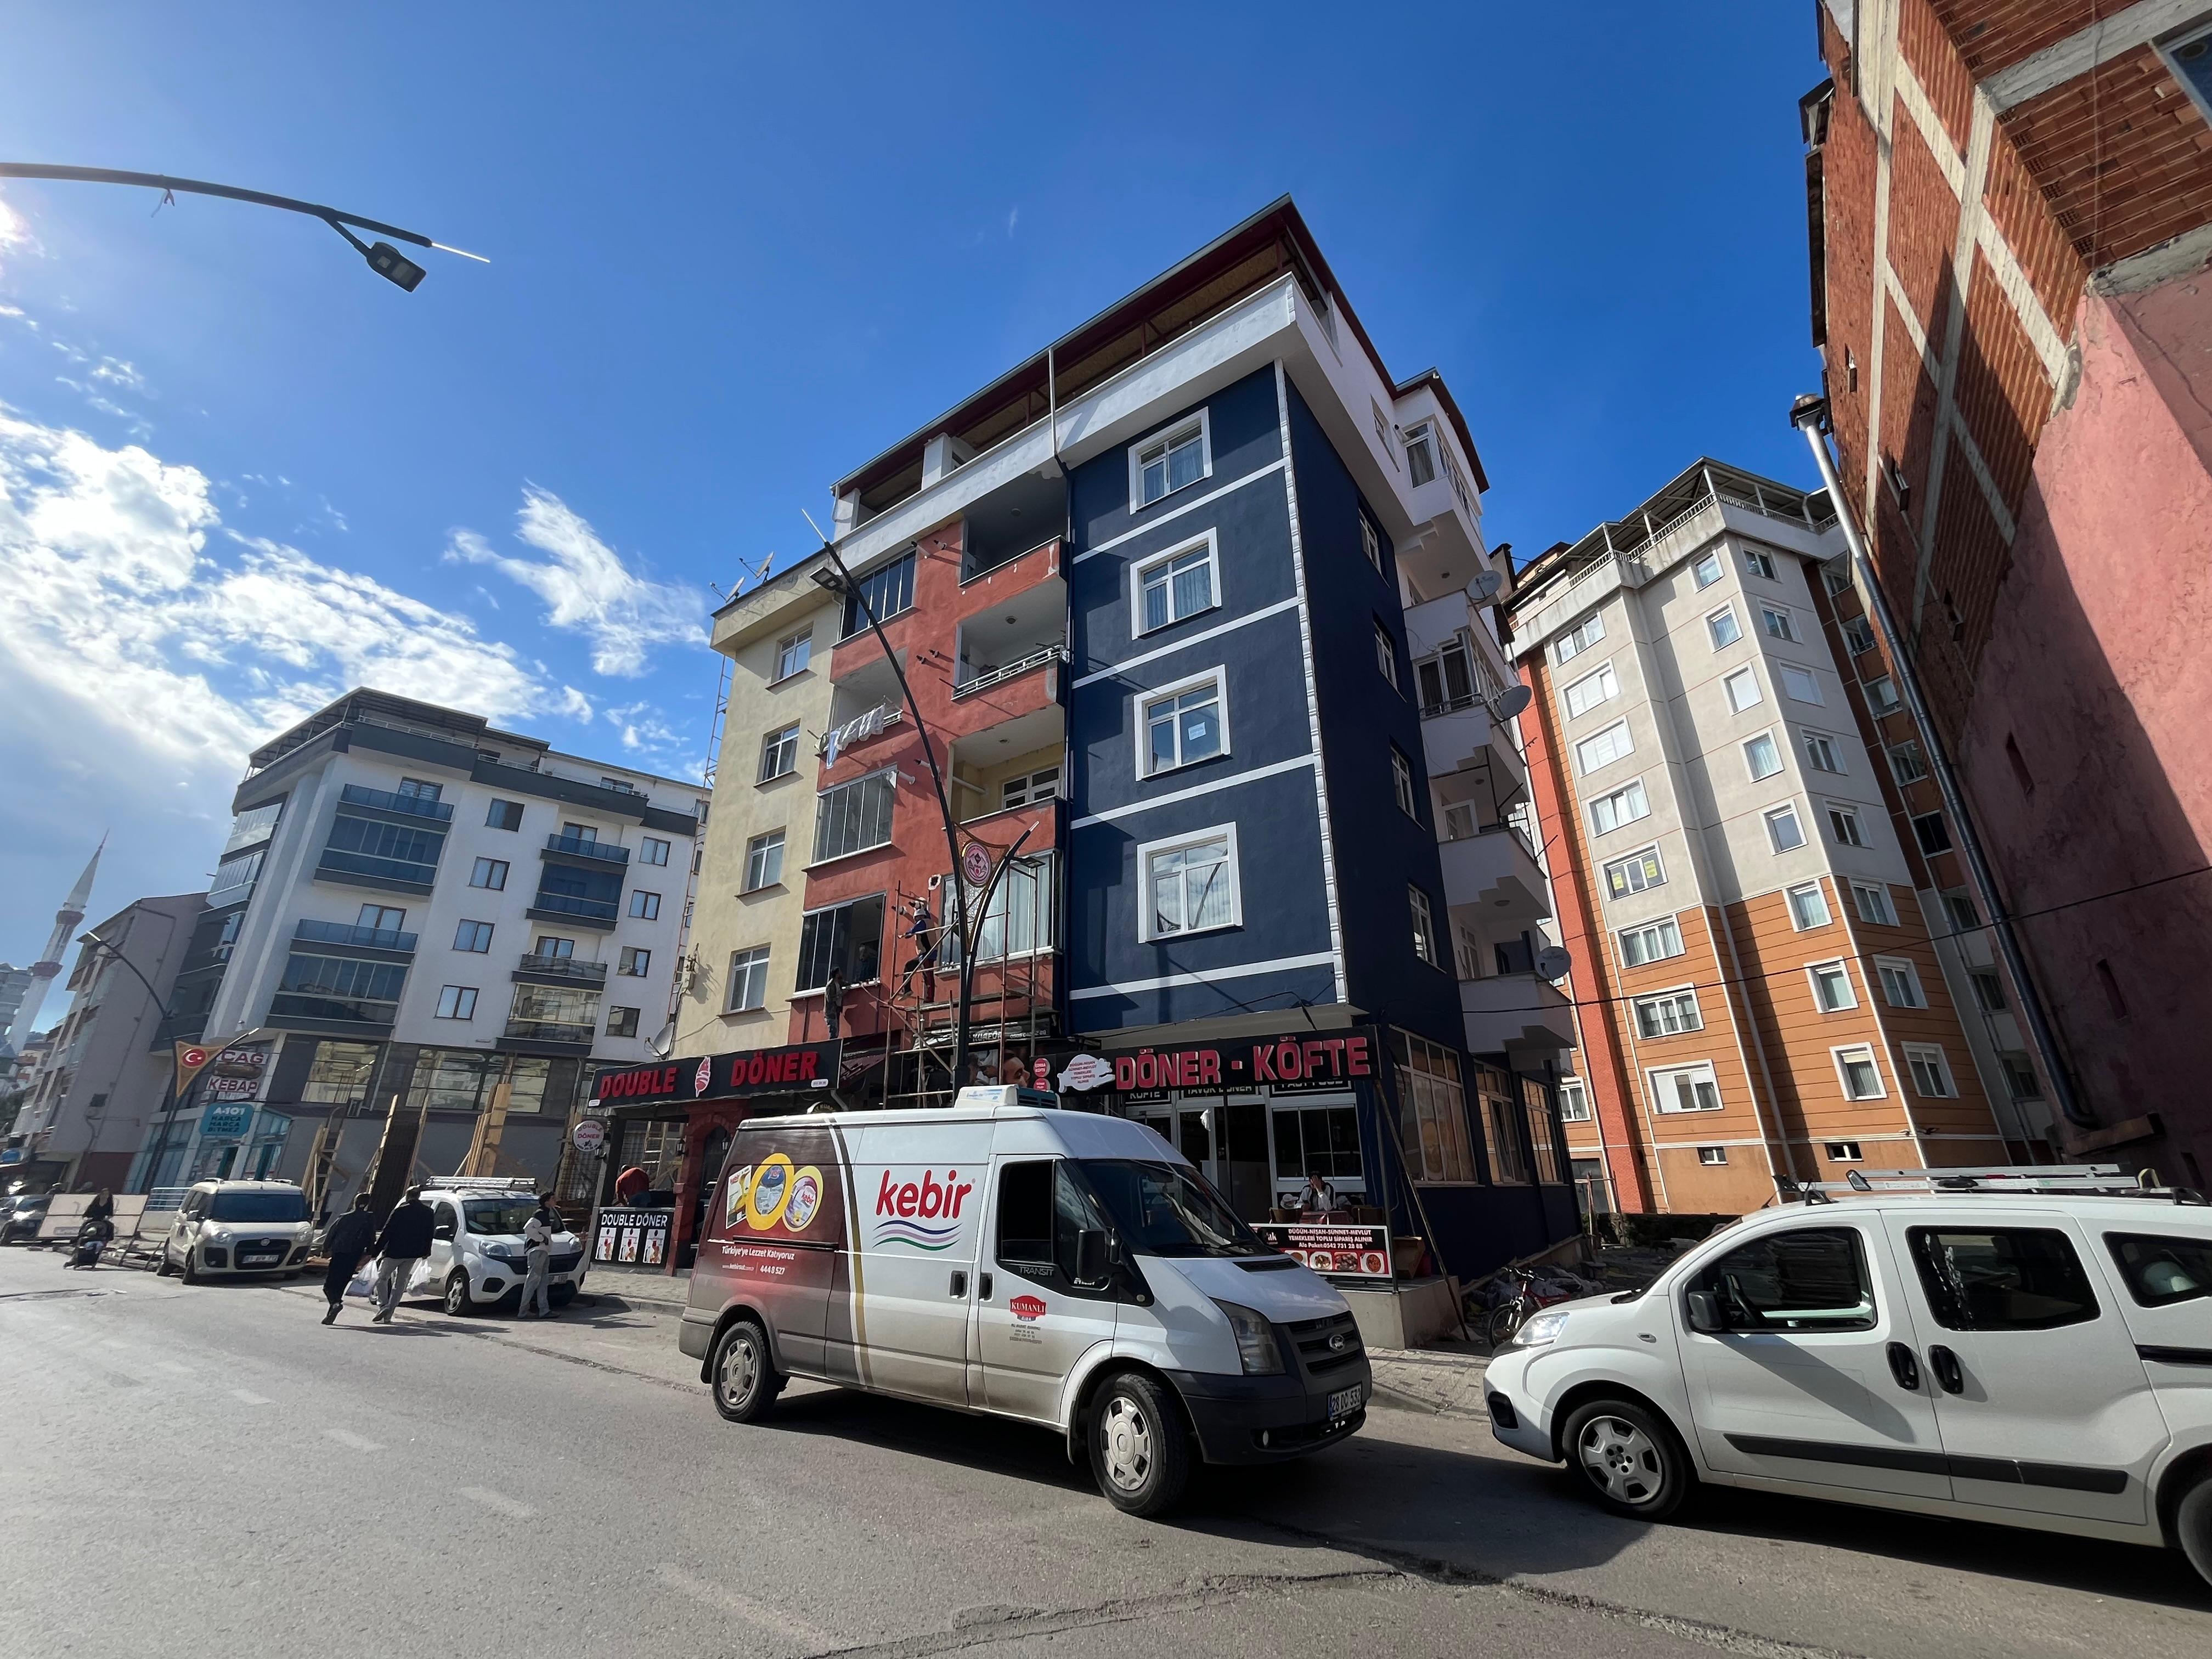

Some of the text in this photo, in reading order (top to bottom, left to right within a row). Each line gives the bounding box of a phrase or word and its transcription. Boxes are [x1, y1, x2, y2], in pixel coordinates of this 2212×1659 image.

[1116, 1048, 1221, 1090] DÖNER
[1253, 1035, 1371, 1081] KÖFTE
[599, 1050, 820, 1099] DOUBLE DÖNER
[208, 1079, 258, 1092] KEBAP
[876, 1169, 973, 1219] kebir
[601, 1212, 668, 1227] DOUBLE DÖNER
[1334, 1235, 1353, 1243] SİPARİŞ
[722, 1245, 795, 1261] Türkiye'ye Lezzet Katıyoruz
[776, 1266, 786, 1275] 527
[1019, 1266, 1054, 1277] TRANSIT
[1011, 1302, 1045, 1313] KUMANLI
[1332, 1396, 1340, 1413] 28
